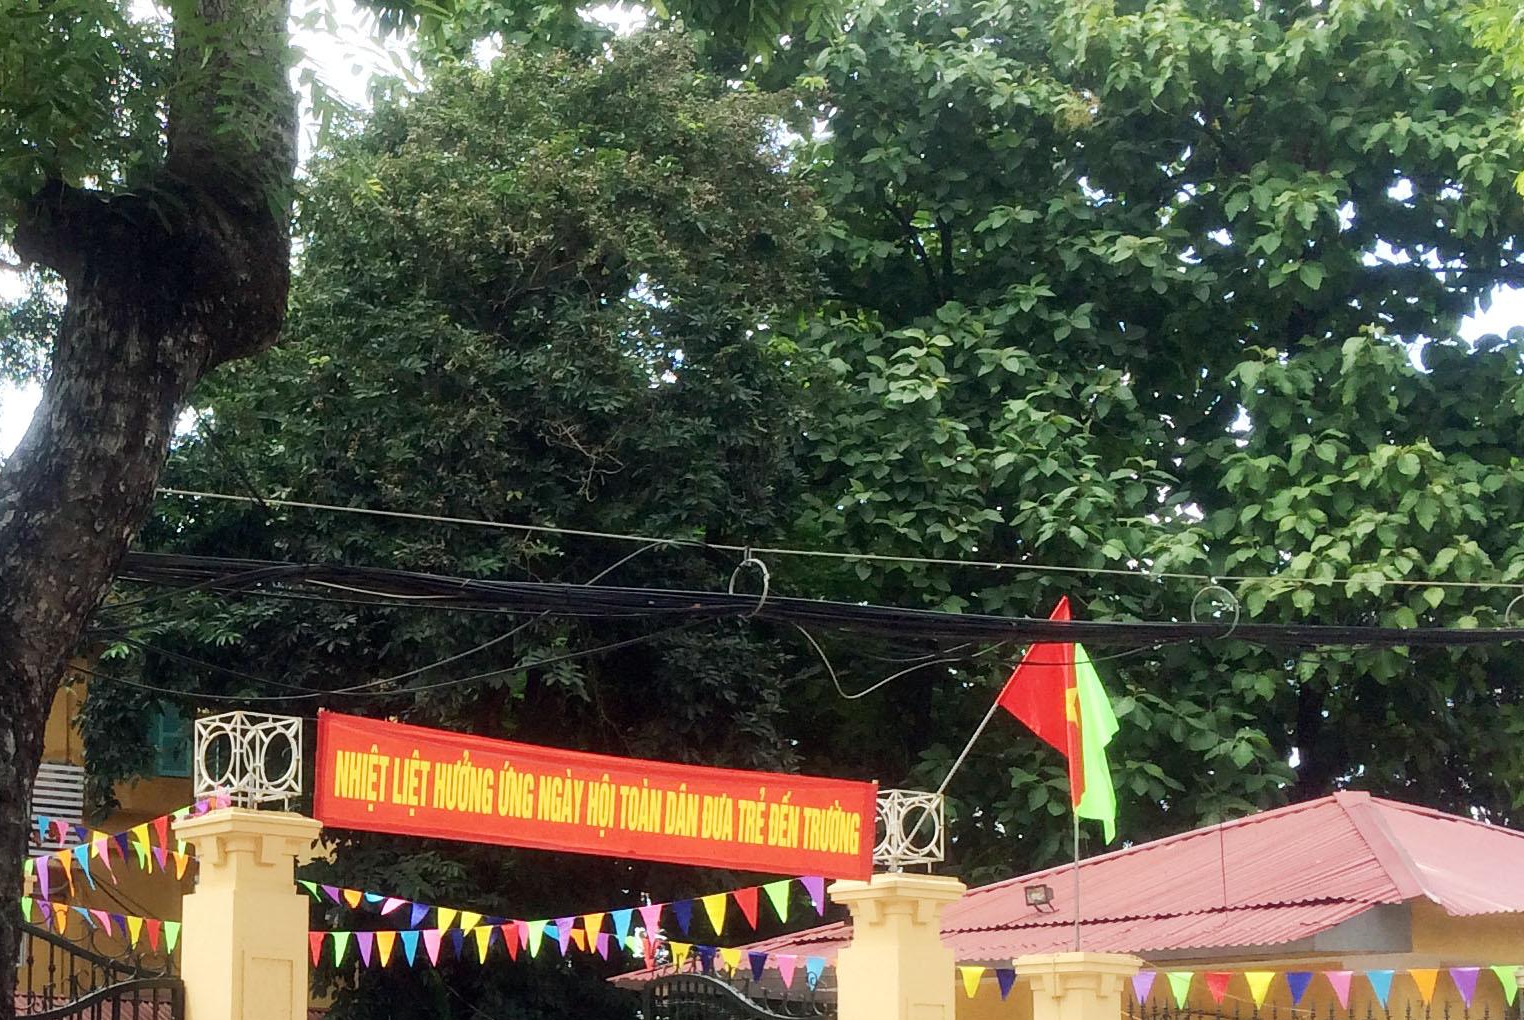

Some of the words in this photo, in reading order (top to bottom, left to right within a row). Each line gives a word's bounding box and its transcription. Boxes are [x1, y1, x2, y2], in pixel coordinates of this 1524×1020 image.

[334, 744, 390, 812] NHIỆT
[392, 750, 431, 817] LIỆT
[433, 750, 494, 814] HƯỞNG
[498, 761, 534, 819] ỨNG
[537, 769, 585, 825] NGÀY
[587, 773, 616, 837] HỘI
[620, 779, 663, 833] TOÀN
[664, 783, 700, 837] DÂN
[701, 793, 733, 842] ĐƯA
[738, 787, 766, 845] TRẺ
[767, 791, 800, 848] ĐẾN
[803, 800, 861, 855] TRƯỜNG
